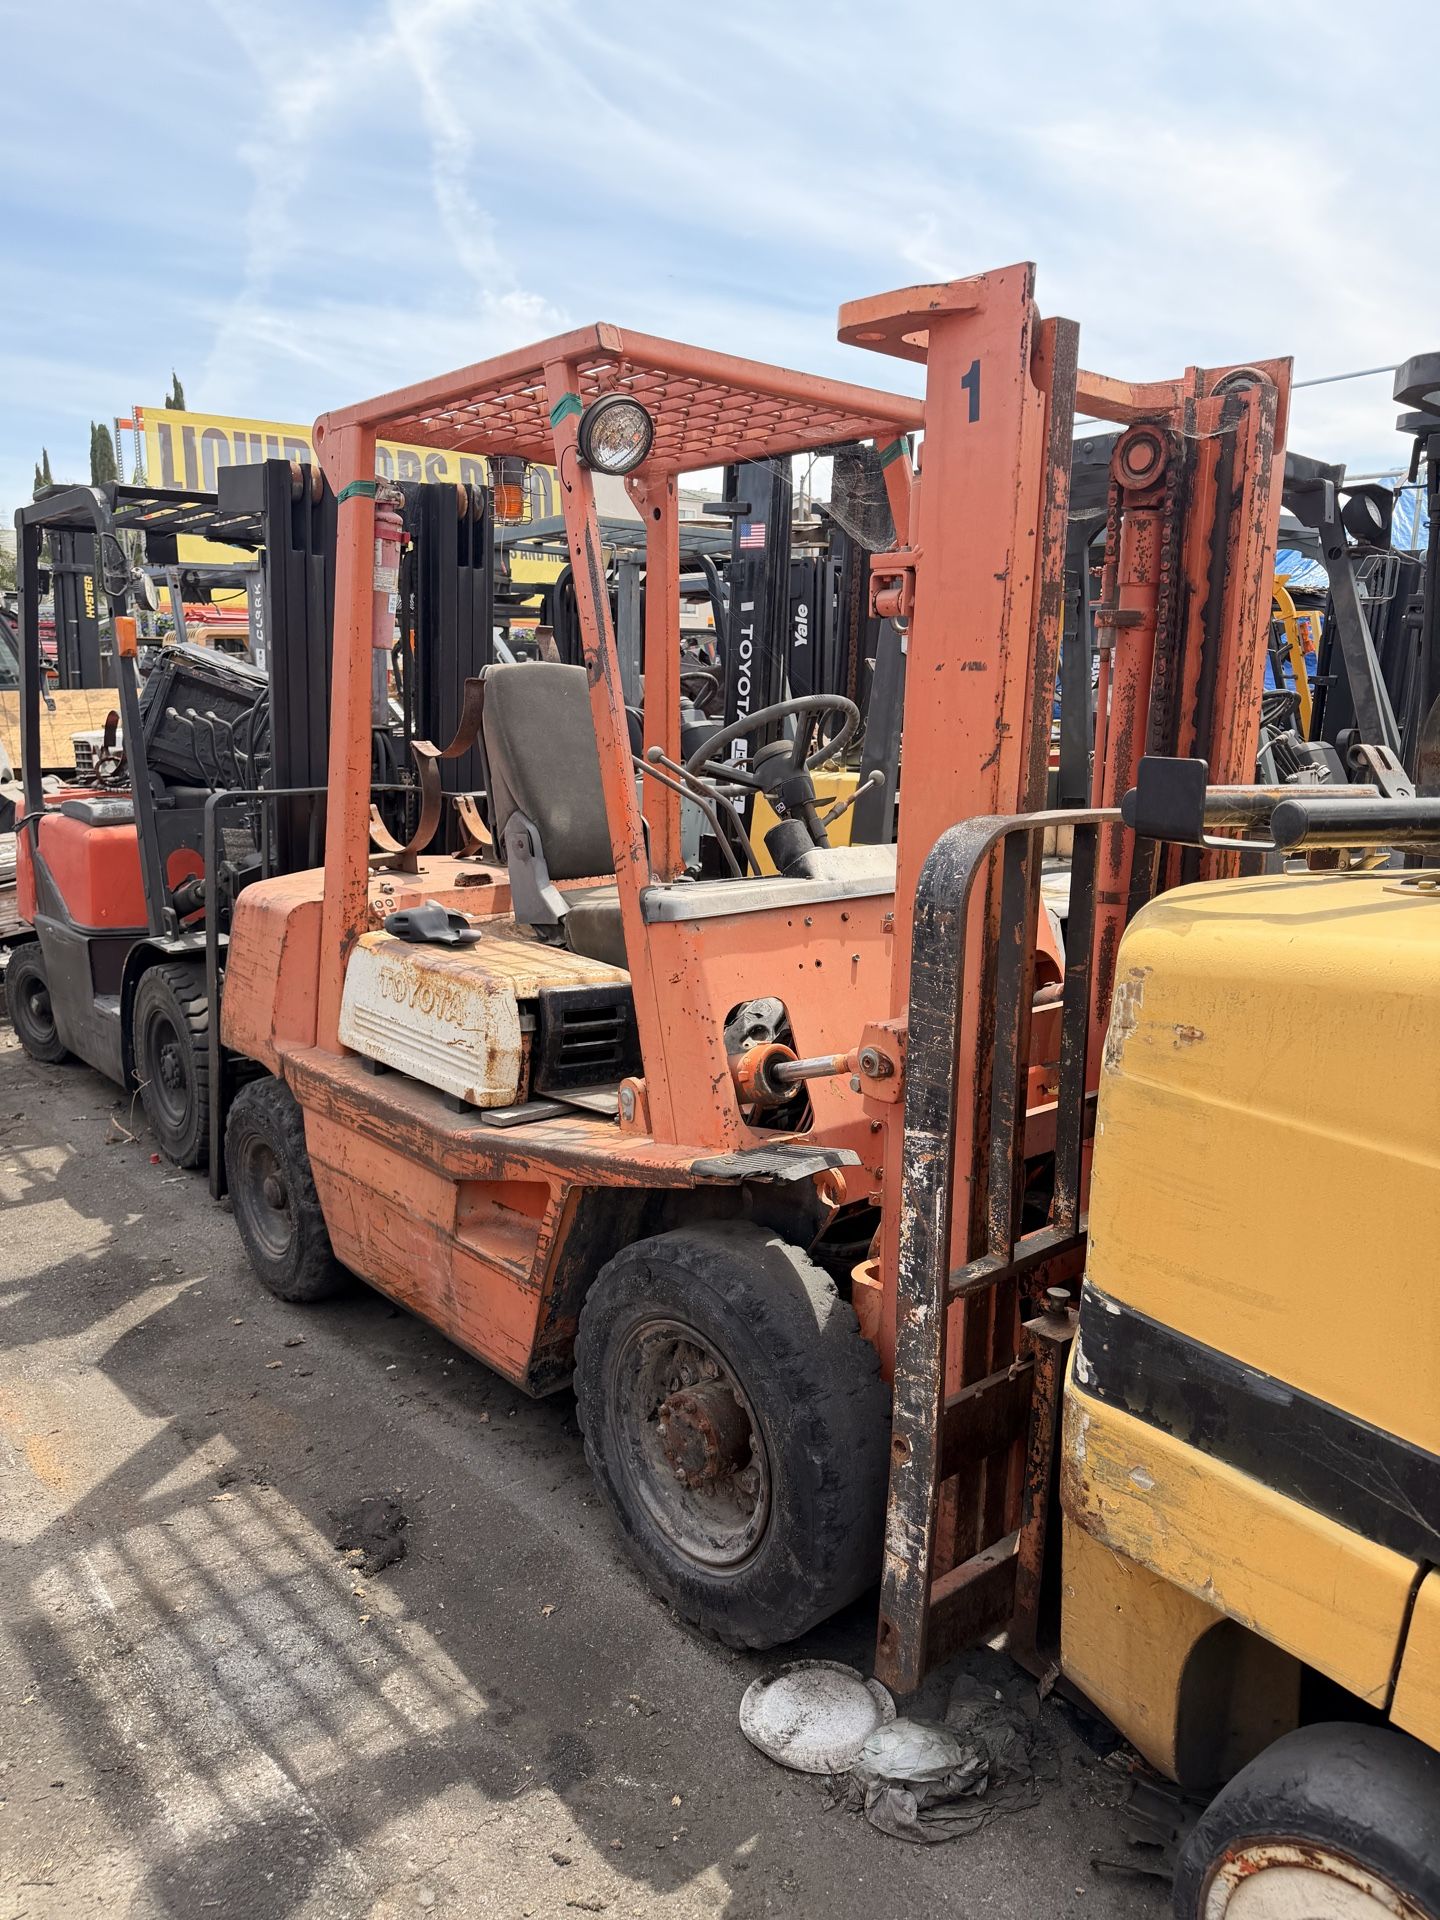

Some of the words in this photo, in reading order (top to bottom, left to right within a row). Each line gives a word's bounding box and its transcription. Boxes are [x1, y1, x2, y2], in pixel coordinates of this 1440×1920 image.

[961, 359, 981, 423] 1
[84, 575, 95, 618] HYSTER
[794, 603, 809, 647] Yale
[380, 965, 463, 1026] TOYOTA
